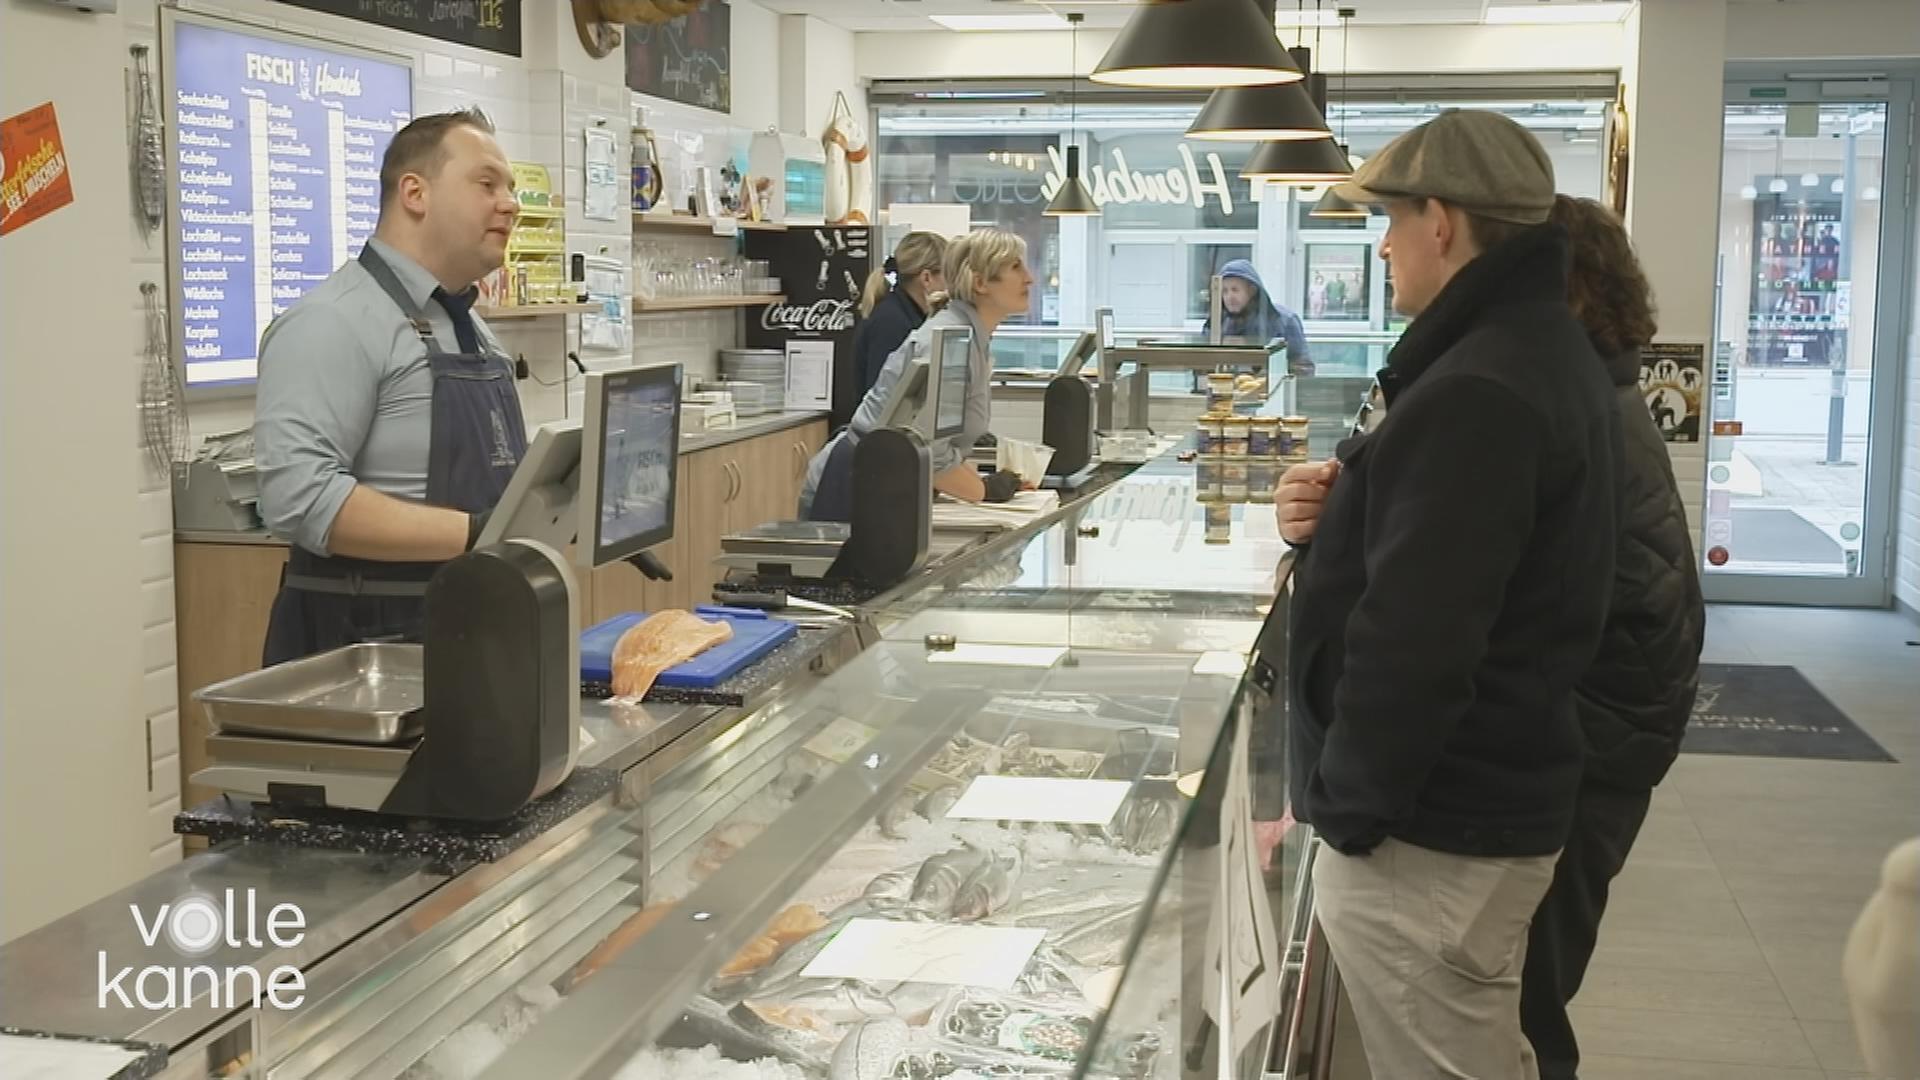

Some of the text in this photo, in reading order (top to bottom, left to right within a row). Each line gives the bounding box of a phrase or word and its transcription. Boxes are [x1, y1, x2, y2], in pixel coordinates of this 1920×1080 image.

[246, 52, 294, 86] FISCH
[180, 150, 218, 168] Kabeljau
[180, 169, 232, 188] Kabeljaufilet
[760, 298, 854, 331] Coca-Cola
